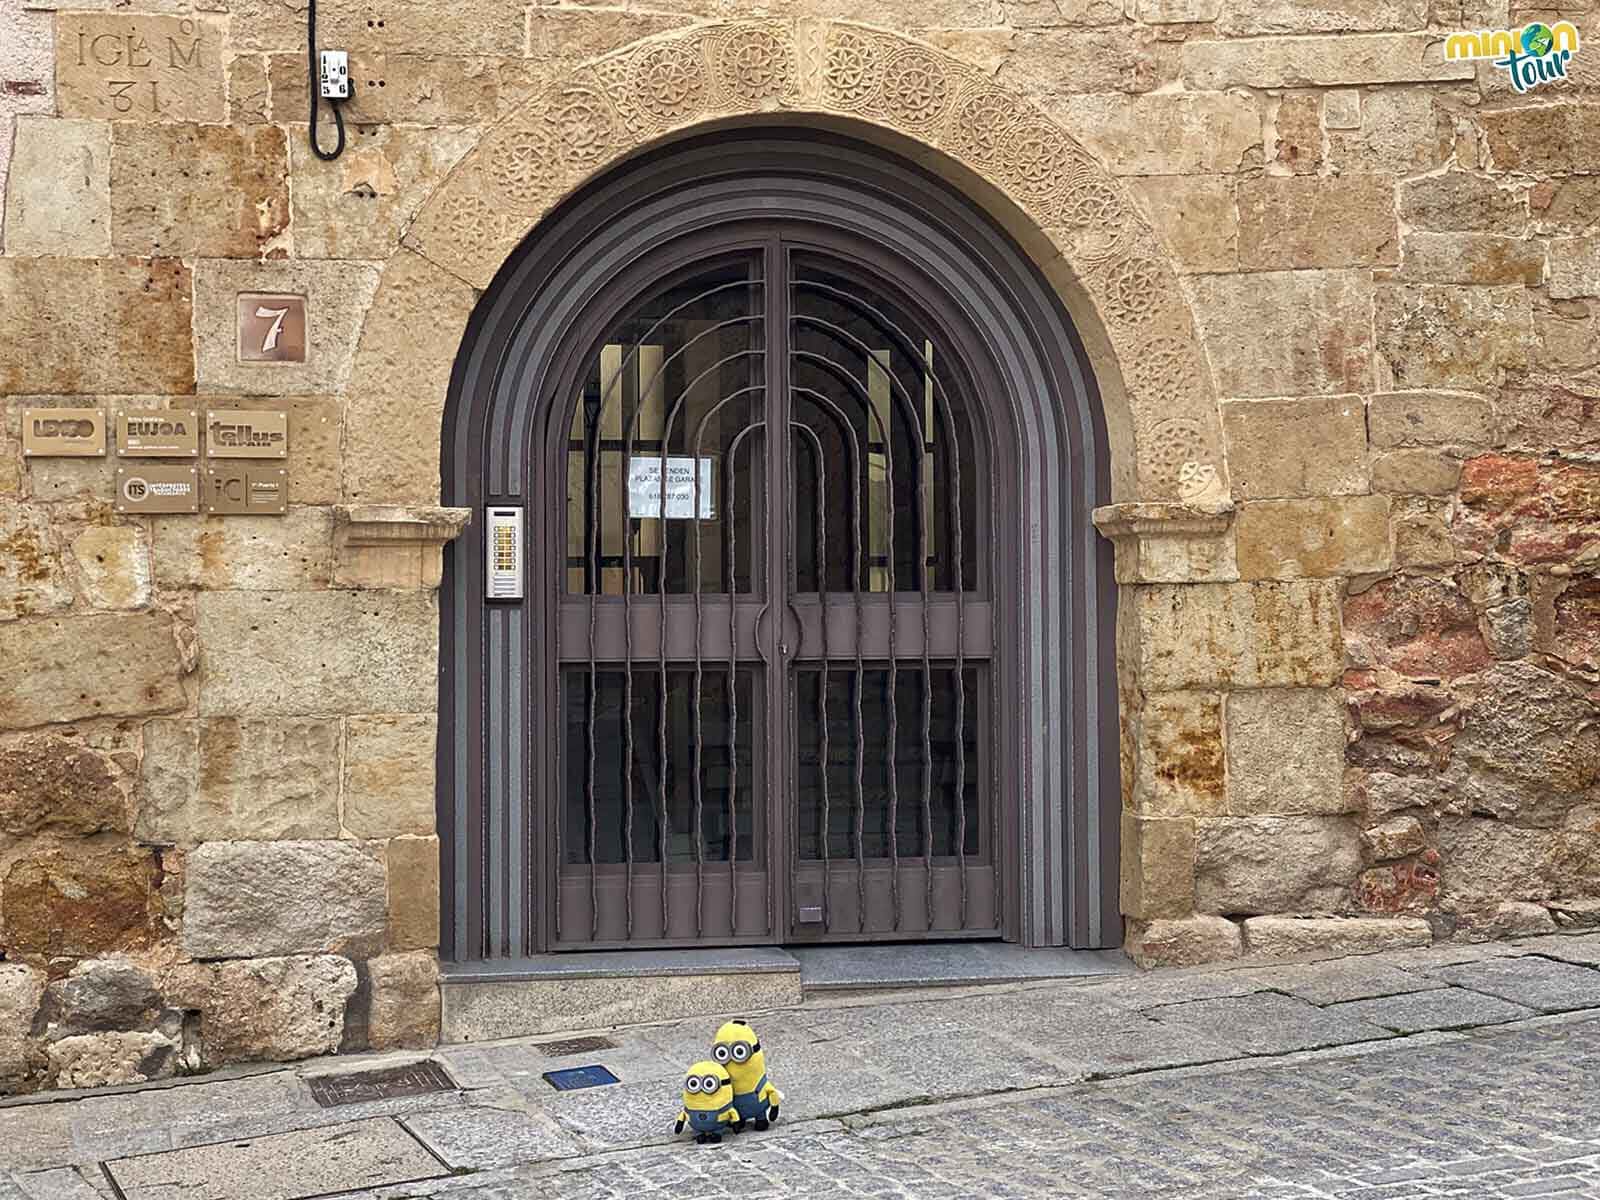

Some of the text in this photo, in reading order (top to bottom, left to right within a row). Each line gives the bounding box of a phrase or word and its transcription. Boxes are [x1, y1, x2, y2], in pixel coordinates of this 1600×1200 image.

[255, 306, 290, 353] 7
[127, 422, 187, 436] EUJOA
[209, 421, 285, 446] tellus
[662, 467, 690, 475] ENDEN
[674, 476, 703, 484] GARA
[128, 484, 146, 496] ITS
